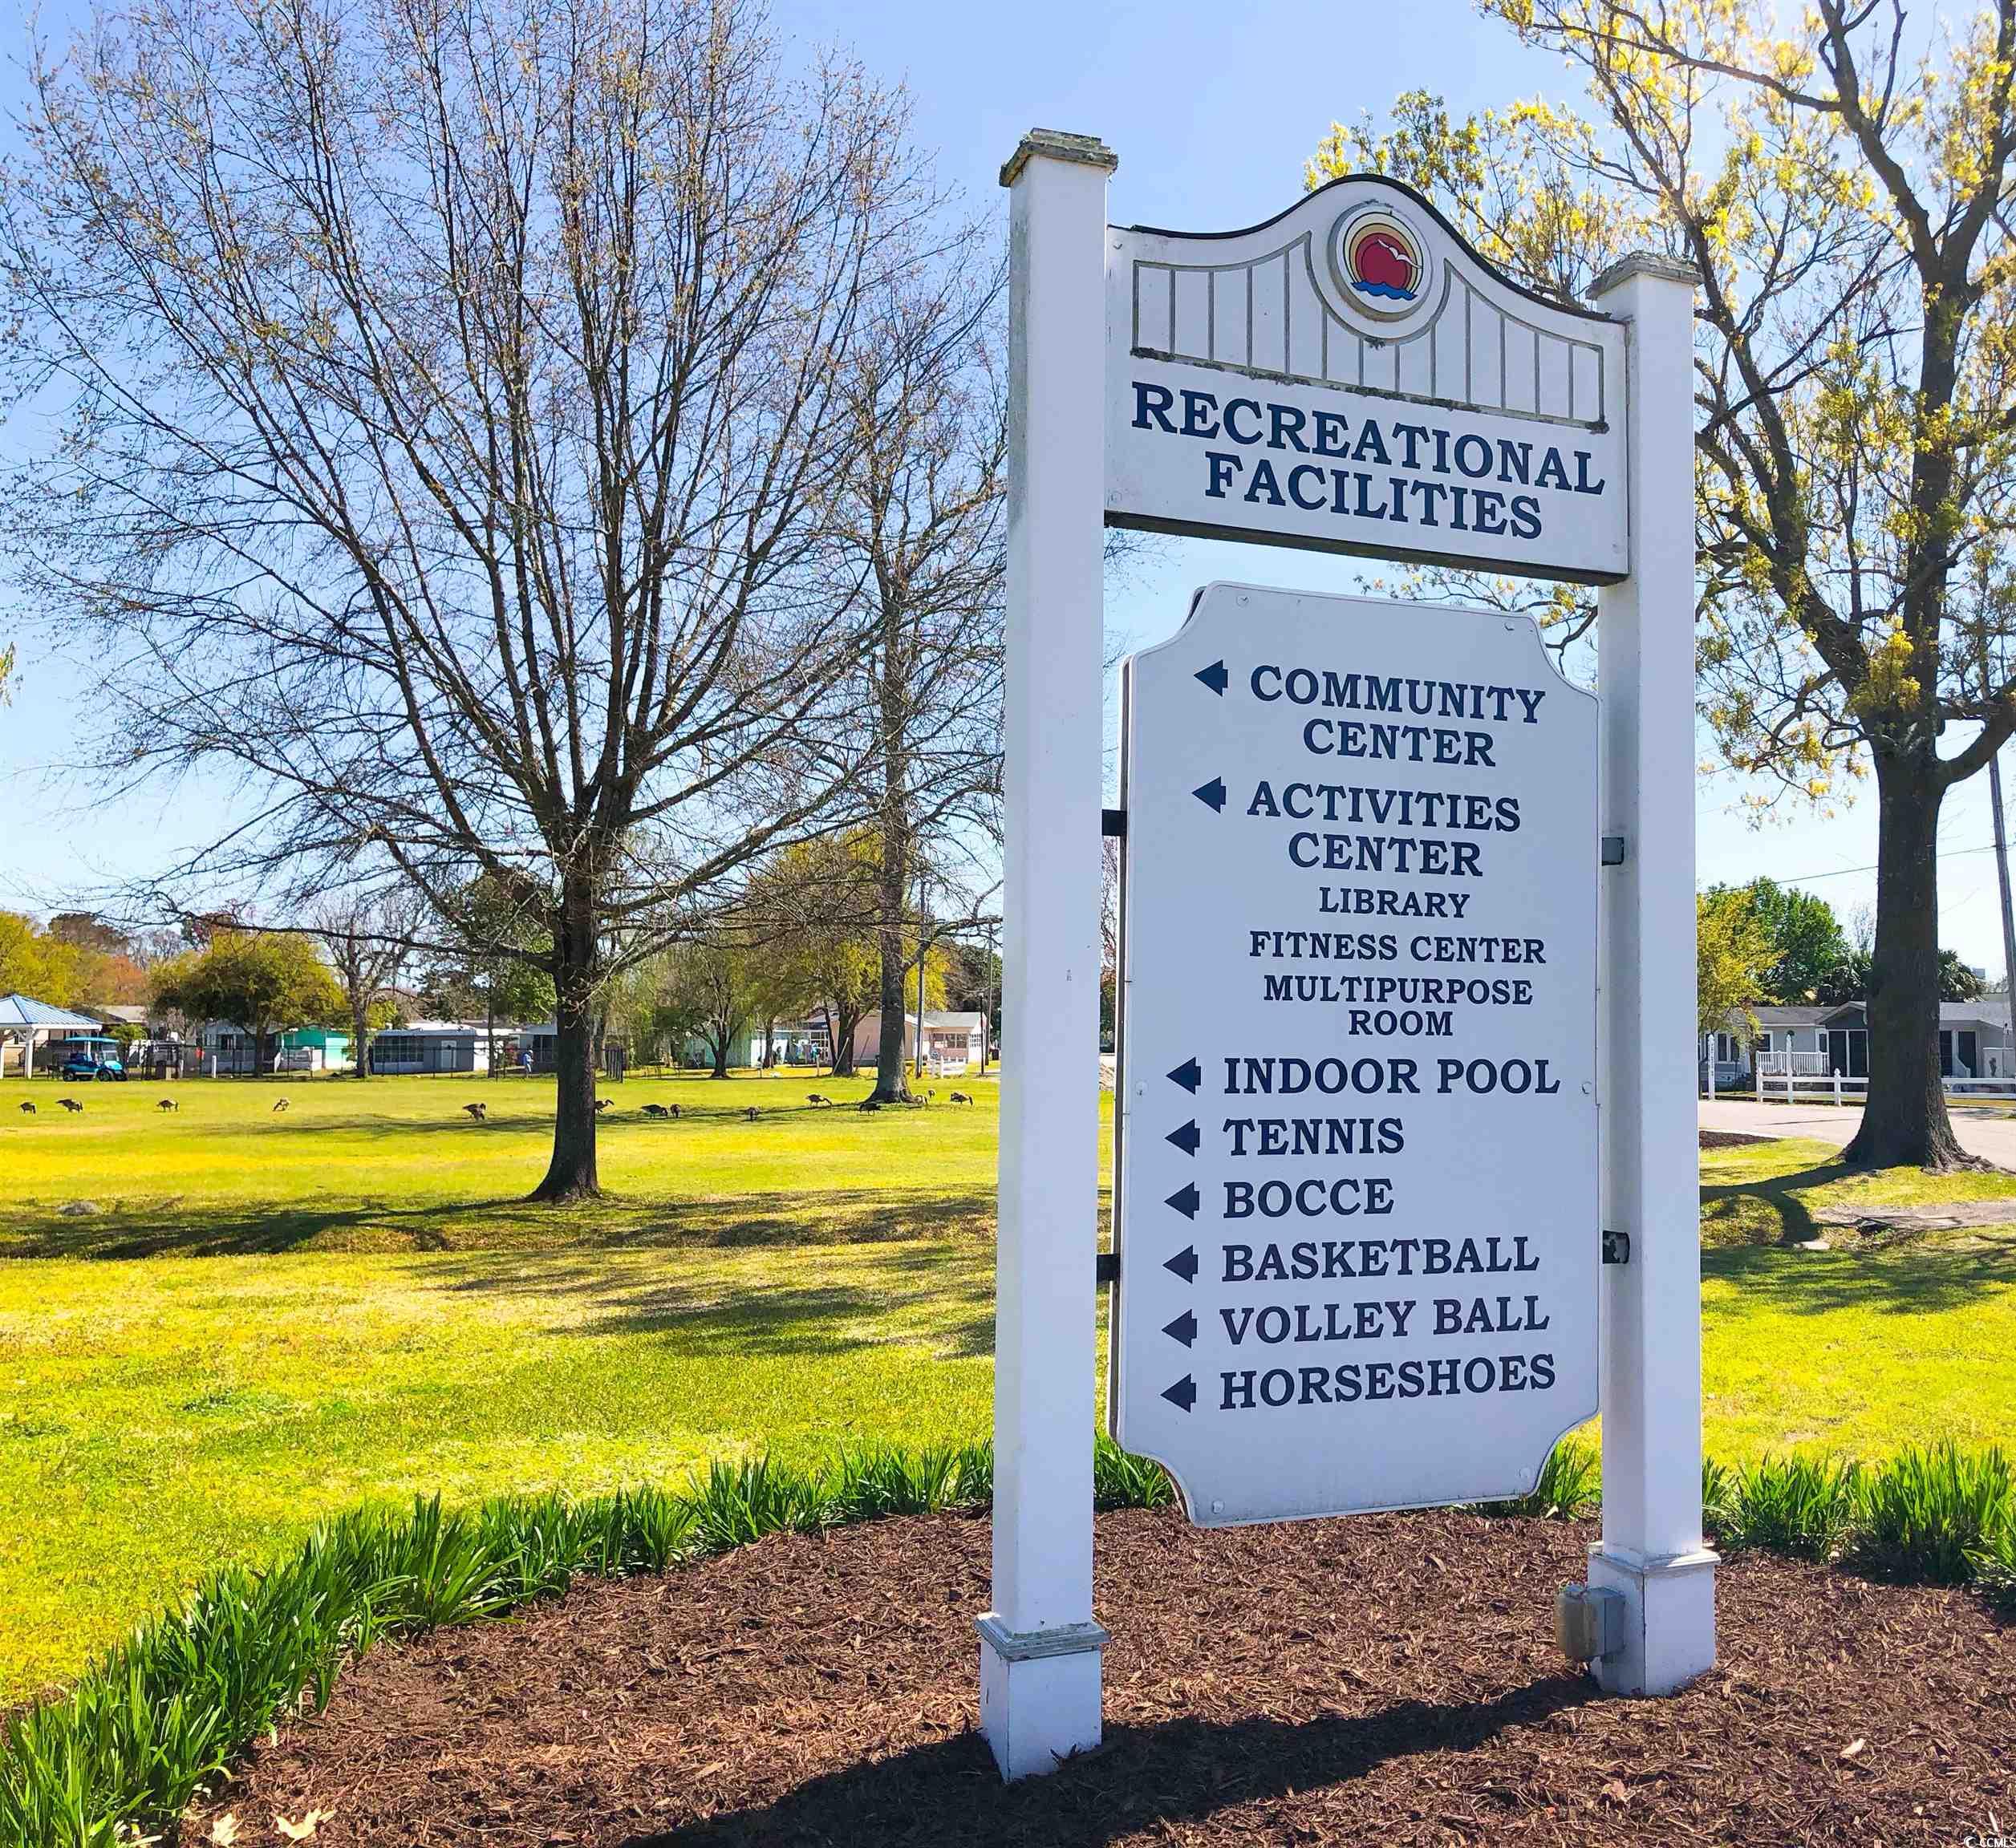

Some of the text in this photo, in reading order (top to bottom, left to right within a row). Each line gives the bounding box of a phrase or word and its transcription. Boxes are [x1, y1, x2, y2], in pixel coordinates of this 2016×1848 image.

[1131, 380, 1606, 496] RECREATIONAL
[1204, 450, 1542, 540] FACILITIES
[1250, 664, 1547, 724] COMMUNITY
[1303, 718, 1496, 768] CENTER
[1246, 780, 1521, 833] ACTIVITIES
[1288, 832, 1483, 877] CENTER
[1319, 886, 1470, 919] LIBRARY
[1249, 930, 1547, 964] FITNESS CENTER
[1263, 975, 1534, 1006] MULTIPURPOSE
[1348, 1009, 1454, 1036] ROOM
[1223, 1057, 1561, 1095] INDOOR POOL
[1222, 1117, 1405, 1157] TENNIS
[1223, 1177, 1394, 1219] BOCCE
[1221, 1236, 1540, 1283] BASKETBALL
[1219, 1295, 1550, 1345] VOLLEY BALL
[1219, 1353, 1556, 1411] HORSESHOES
